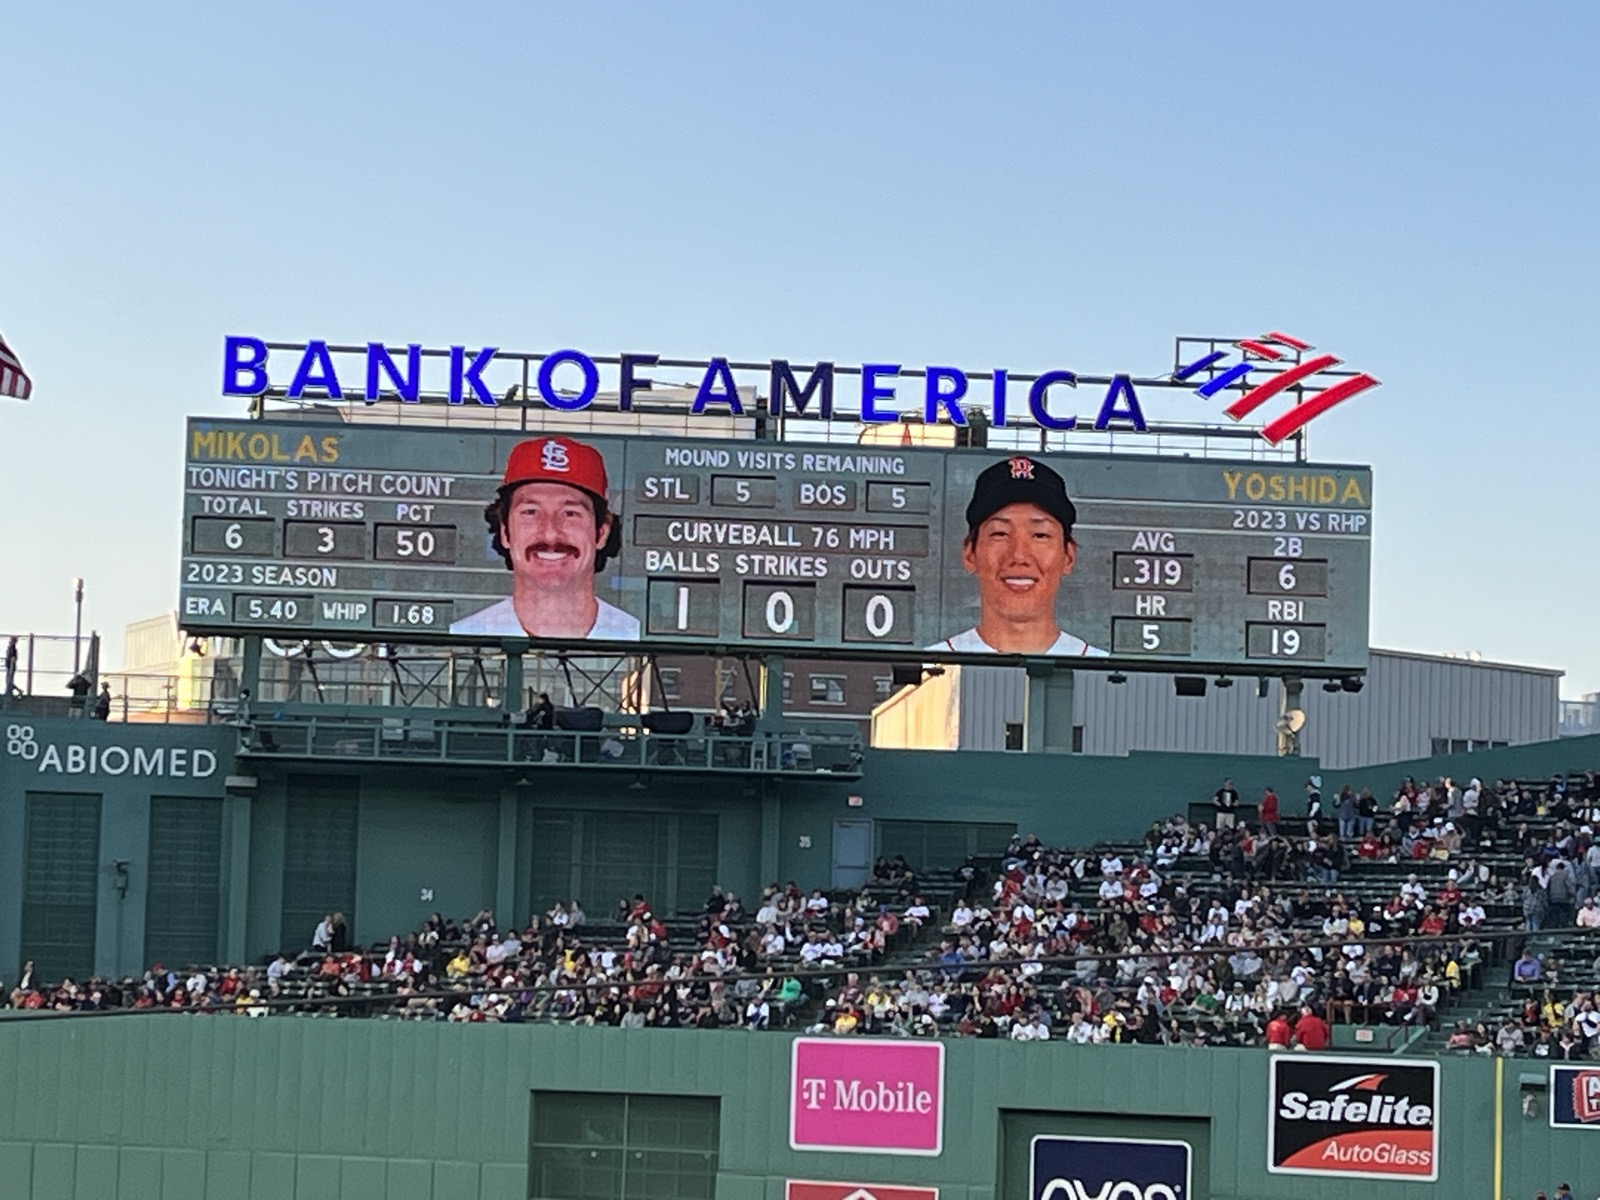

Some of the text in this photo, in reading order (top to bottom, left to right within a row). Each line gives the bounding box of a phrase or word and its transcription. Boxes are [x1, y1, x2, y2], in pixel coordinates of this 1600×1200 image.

[222, 334, 1149, 433] BANK OF AMERICA
[192, 430, 341, 463] MIKOLAS
[665, 448, 905, 475] MOUND VISITS REMAINING
[188, 467, 455, 497] TONIGHT'S PITCH COUNT
[644, 477, 691, 499] STL
[736, 481, 751, 503] 5
[1222, 470, 1365, 504] YOSHIDA
[201, 496, 268, 515] TOTAL
[800, 483, 848, 506] BOS
[891, 487, 906, 509] 5
[287, 499, 364, 519] STRIKES
[396, 503, 435, 522] PCT
[1233, 510, 1368, 533] 2023 VS RHP
[224, 523, 243, 549] 6
[316, 527, 335, 553] 3
[396, 531, 435, 556] 50
[667, 522, 895, 551] CURVEBALL 76 MPH
[1131, 532, 1175, 552] AVG
[1273, 537, 1303, 558] 2B
[645, 550, 720, 573] BALLS
[735, 554, 828, 577] STRIKES
[850, 559, 911, 581] OUTS
[1122, 559, 1182, 586] .319
[187, 563, 338, 587] 2023 SEASON
[1278, 564, 1297, 590] 6
[185, 596, 226, 616] ERA
[249, 599, 298, 620] 5.40
[322, 602, 367, 621] WHIP
[392, 604, 435, 625] 1.68
[676, 586, 690, 631] 1
[765, 590, 795, 634] 0
[865, 594, 895, 638] 0
[1135, 595, 1166, 616] HR
[1267, 600, 1304, 621] RBI
[1142, 624, 1161, 650] 5
[1271, 629, 1301, 655] 19
[38, 744, 218, 778] ABIOMED
[802, 1079, 933, 1115] T Mobile
[1279, 1092, 1433, 1126] Safelite
[1321, 1141, 1432, 1166] AutoGlass
